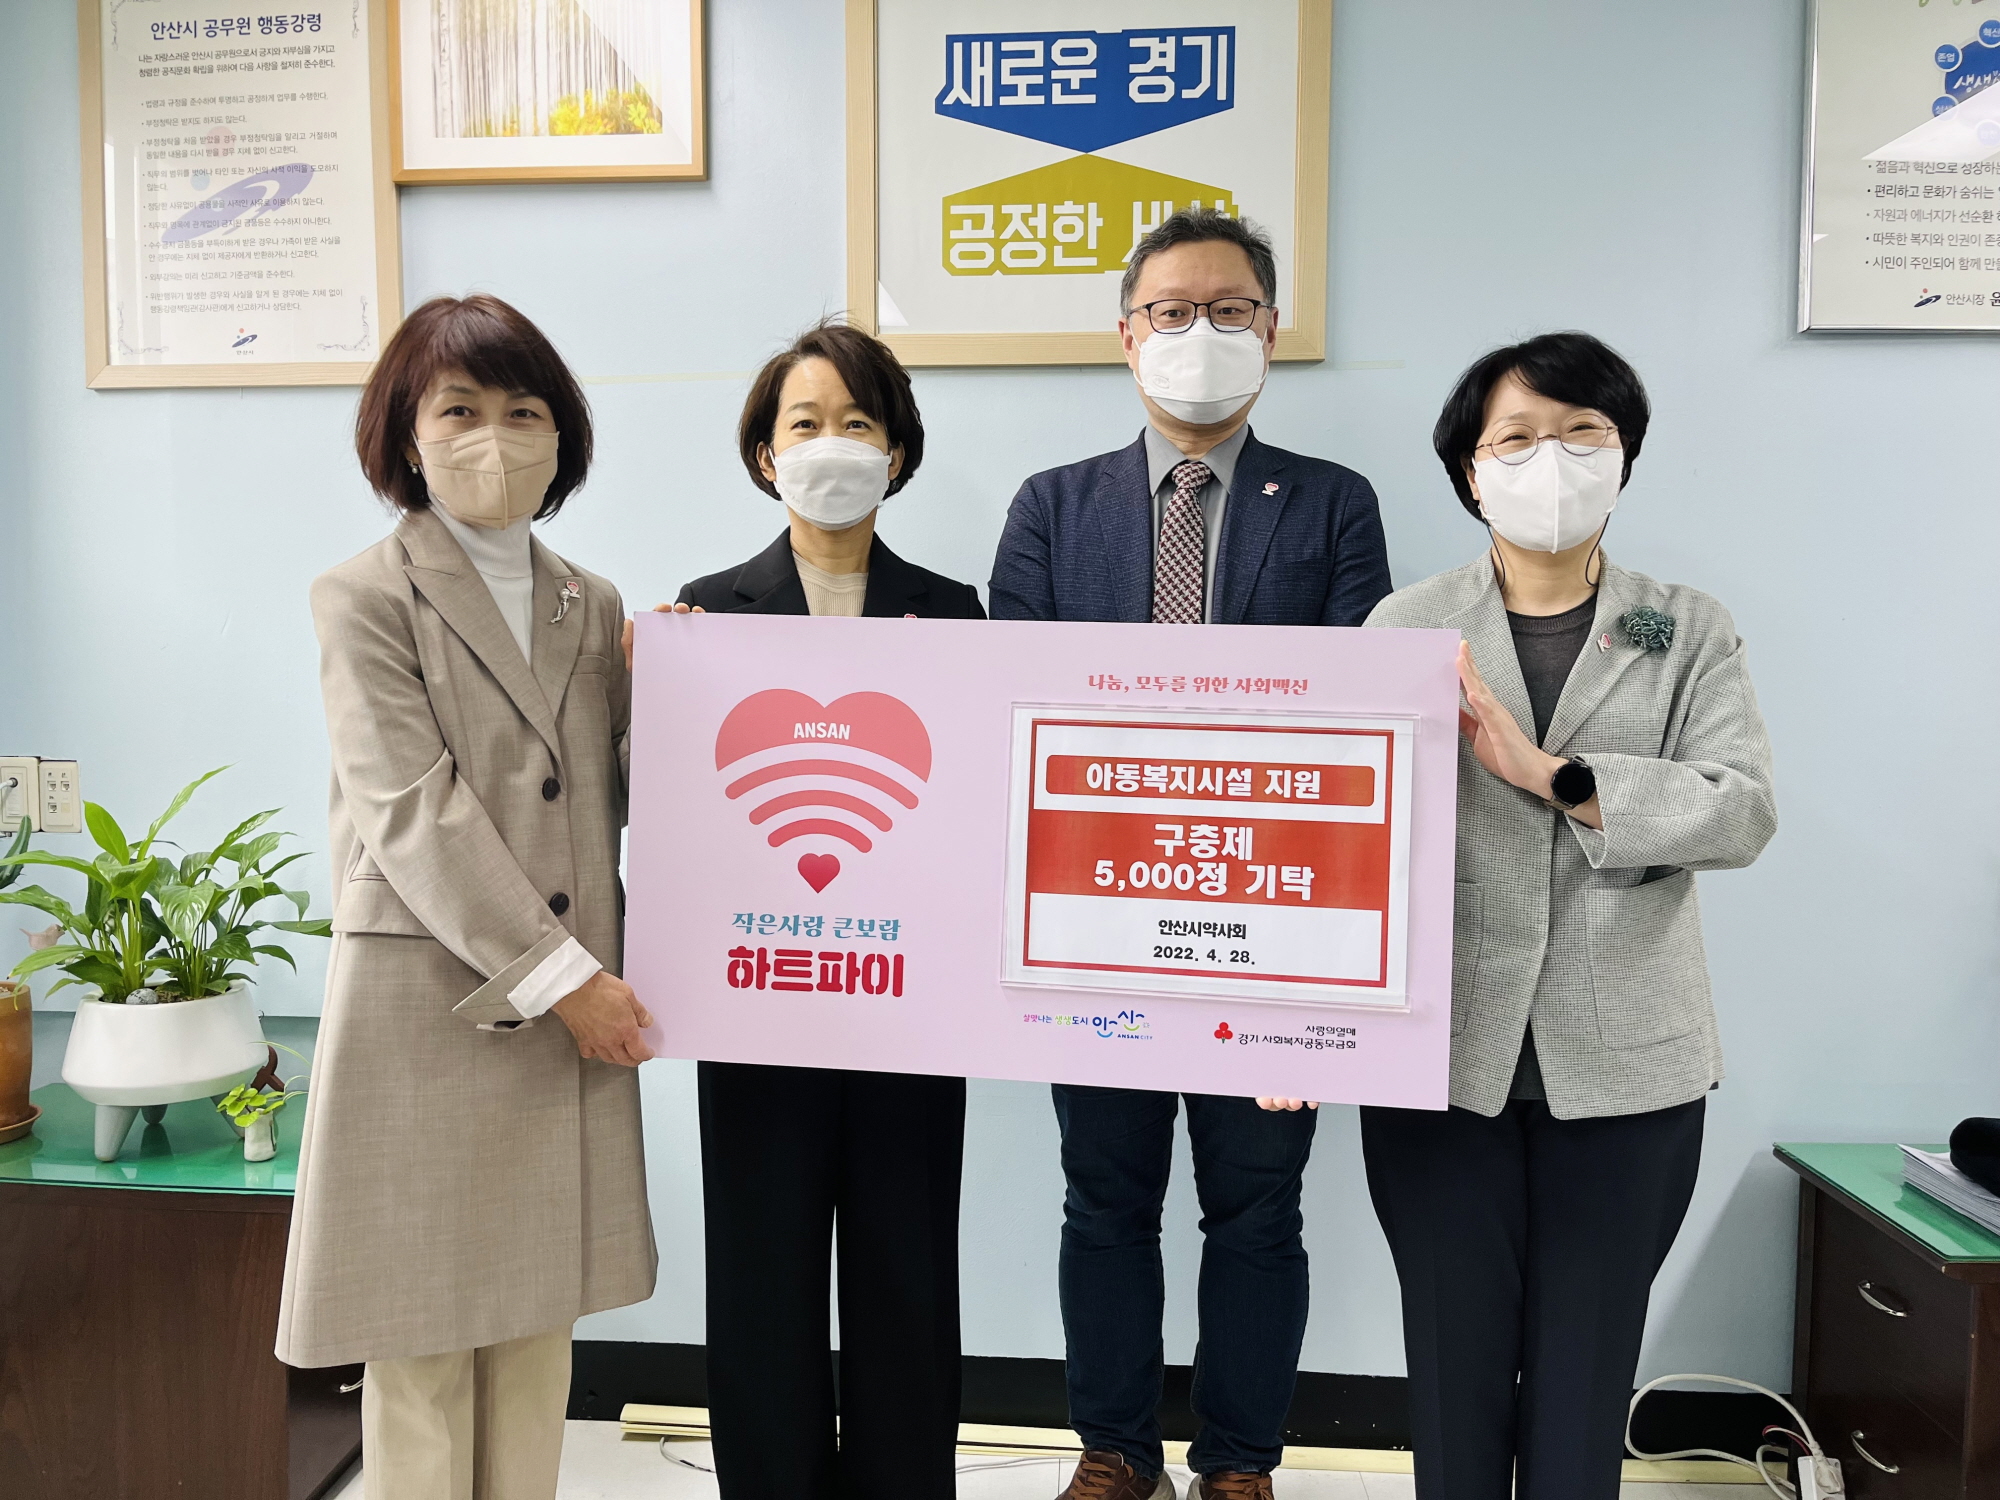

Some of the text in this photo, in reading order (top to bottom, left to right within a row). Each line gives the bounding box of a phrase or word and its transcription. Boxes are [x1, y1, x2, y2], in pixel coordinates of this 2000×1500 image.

[151, 13, 322, 40] 안산시 공무원 행동강령
[139, 44, 335, 63] 나는 자랑스러운 안산시 공무원으로서 긍지와 자부심을 가지고
[139, 59, 335, 77] 청렴한 공직문화 확립을 위하여 다음 사항을 철저히 준수한다.
[942, 34, 1228, 107] 새로운 경기
[1876, 160, 1910, 174] 젊음과
[1914, 162, 1958, 174] 혁신으로
[1875, 184, 1994, 199] 편리하고 문화가 숨쉬는
[1874, 208, 1993, 223] 자원과 에너지가 선순환
[949, 201, 1103, 269] 공정한
[1873, 232, 1907, 246] 따뜻한
[1910, 233, 1944, 246] 복지와
[1948, 234, 1980, 246] 인권이
[1873, 256, 1906, 270] 시민이
[1910, 257, 1954, 270] 주인되어
[1959, 257, 1981, 270] 함께
[1946, 294, 1985, 306] 안산시장
[1088, 674, 1308, 696] 나눔, 모두를 위한 사회백신
[793, 722, 850, 740] ANSAN
[1086, 763, 1320, 799] 아동복지시설 지원
[1154, 823, 1252, 860] 구충제
[1094, 860, 1314, 900] 5,000정 기탁
[732, 912, 901, 940] 작은사랑 큰보람
[1158, 919, 1246, 939] 안산시약사회
[1153, 946, 1256, 965] 2022. 4. 28.
[727, 945, 904, 997] 하트파이
[1024, 1014, 1052, 1024] 살맛나는
[1055, 1015, 1088, 1026] 생생도시
[1306, 1026, 1356, 1037] 사랑의열매
[1238, 1034, 1356, 1050] 경기 사회복지공동모금회
